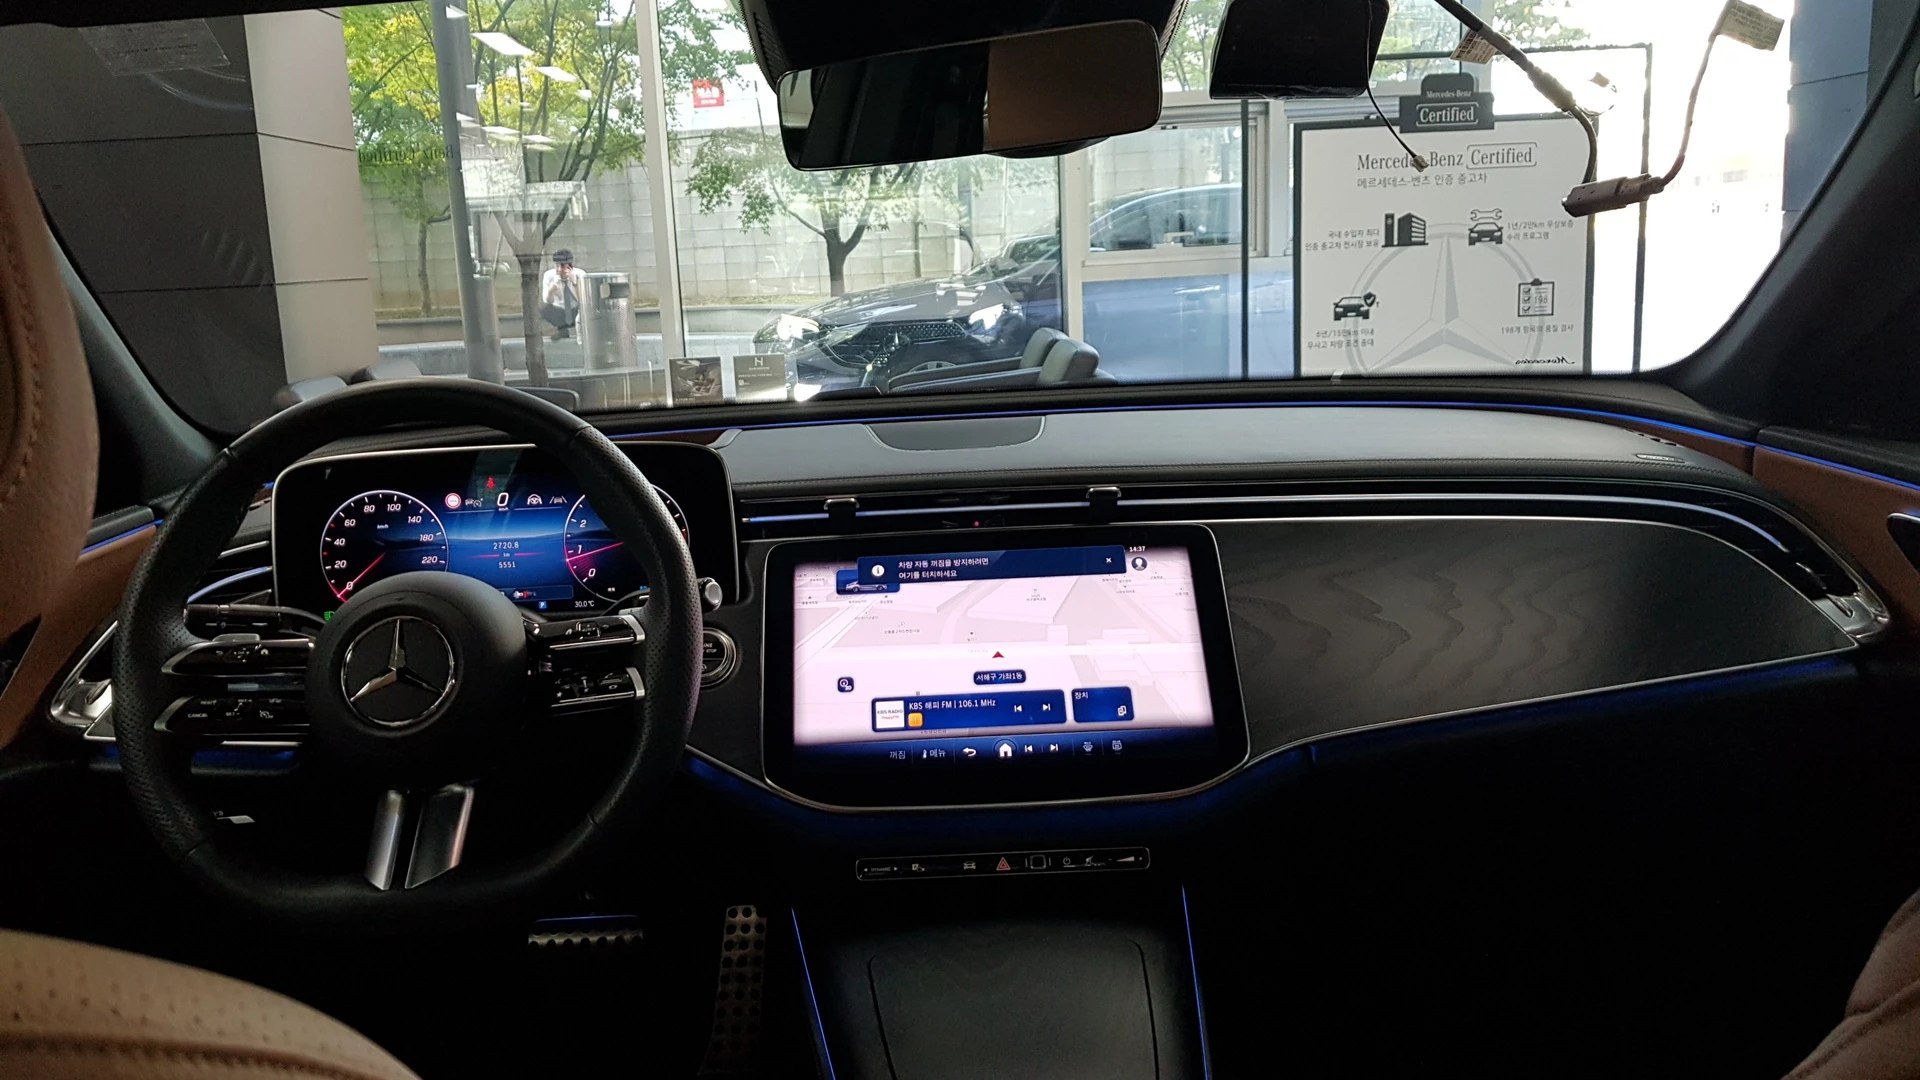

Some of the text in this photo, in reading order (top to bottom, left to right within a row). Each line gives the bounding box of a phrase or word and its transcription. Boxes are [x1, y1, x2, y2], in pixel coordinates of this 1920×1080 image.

[1426, 89, 1472, 98] Mercedes-Benz
[1419, 106, 1475, 123] Certified
[1357, 147, 1532, 170] Merced-Benz Certified
[1357, 172, 1488, 189] 메르세데스-벤츠 인증 중고차
[1328, 230, 1342, 239] 국내
[1534, 295, 1548, 304] 198
[496, 492, 509, 507] 0
[363, 504, 375, 513] 80
[387, 503, 401, 512] 100
[344, 519, 356, 527] 60
[407, 516, 422, 524] 140
[579, 519, 587, 528] 2
[333, 538, 346, 546] 40
[419, 534, 434, 542] 180
[493, 541, 520, 550] 2720.8
[577, 545, 583, 554] 1
[334, 560, 347, 569] 20
[421, 556, 438, 564] 220
[898, 557, 989, 569] 차량 자동 꺼짐을 방지하려면
[588, 568, 596, 577] 0
[898, 570, 957, 580] 여기를 터치하세요
[346, 582, 354, 590] 0
[976, 672, 1023, 681] 서해구 가좌1동
[1074, 691, 1089, 700] 장치
[909, 702, 923, 710] KBS
[925, 701, 940, 710] 해피
[941, 701, 952, 709] FM
[958, 699, 978, 708] 106.1
[980, 699, 996, 707] MHz
[889, 750, 906, 760] 꺼짐
[929, 748, 946, 757] 메뉴
